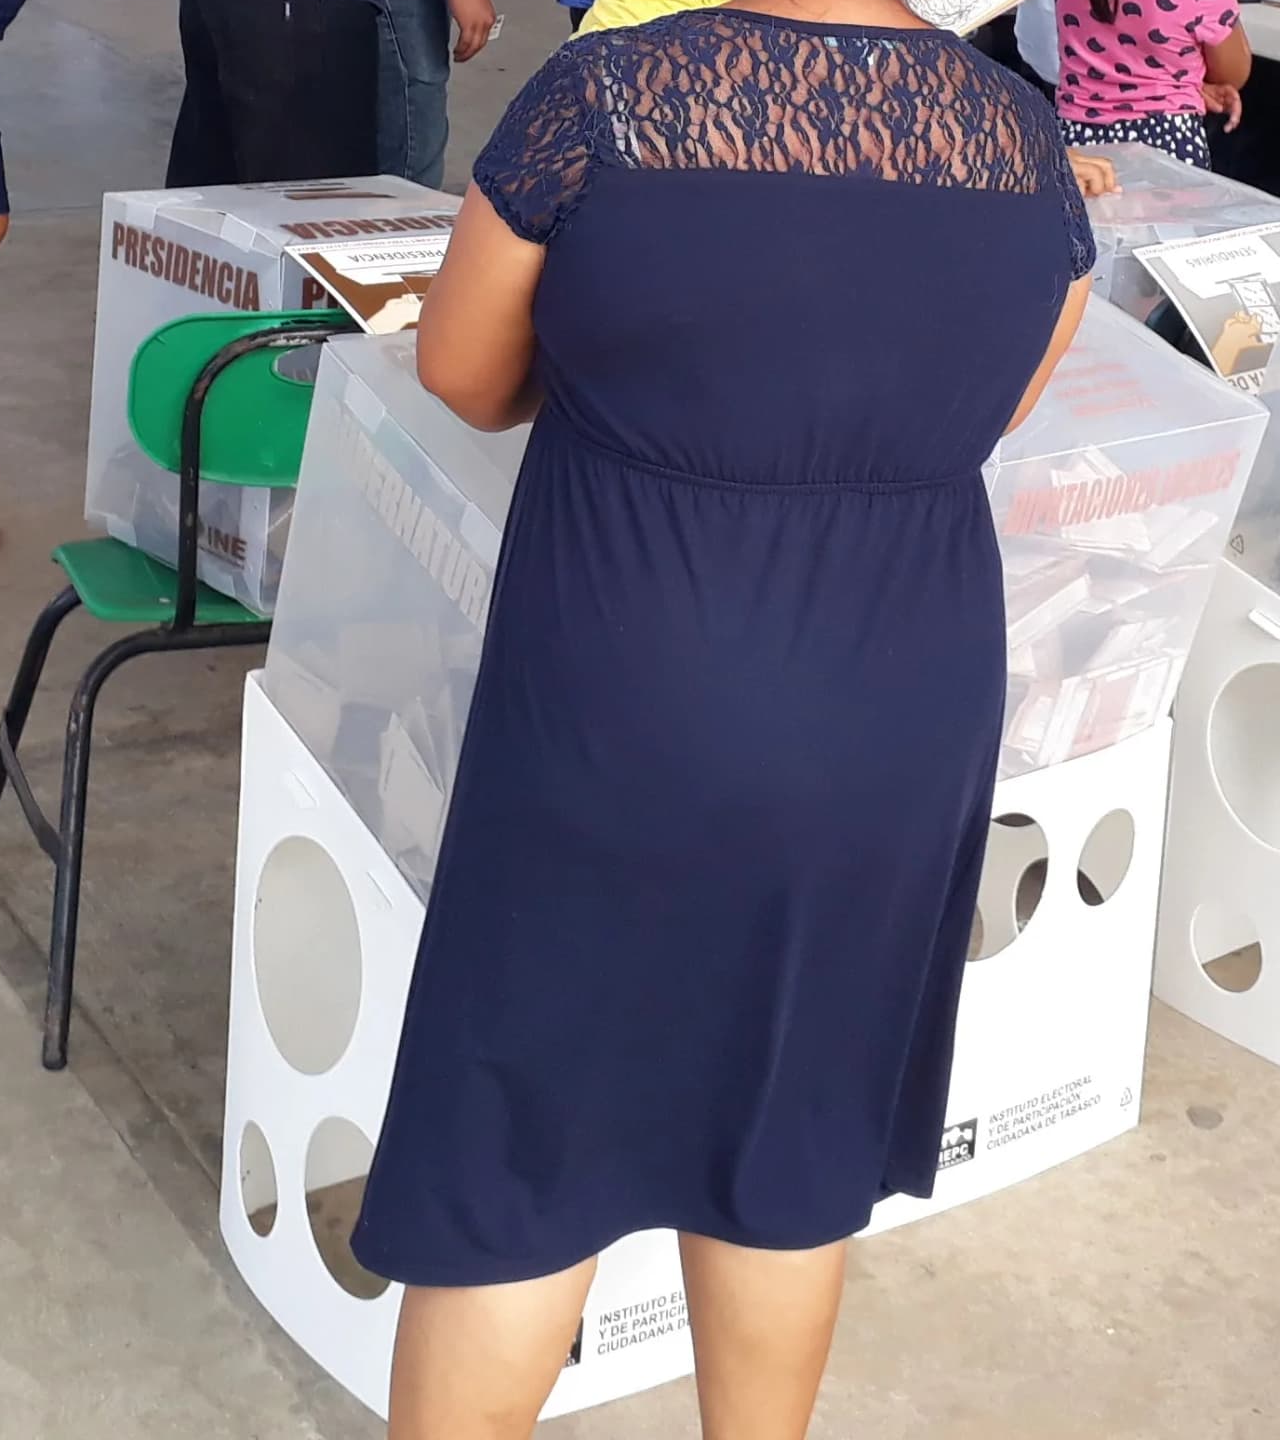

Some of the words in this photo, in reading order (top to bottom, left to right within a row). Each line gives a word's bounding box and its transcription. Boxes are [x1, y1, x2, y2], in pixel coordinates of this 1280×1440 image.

[111, 220, 261, 312] PRESIDENCIA
[207, 526, 248, 562] INE
[989, 1097, 1039, 1125] INSTITUTO
[1039, 1075, 1092, 1105] ELECTORAL
[986, 1120, 1043, 1151] CIUDADANA
[1045, 1115, 1057, 1128] DE
[1060, 1094, 1102, 1121] TABASCO
[996, 1122, 1010, 1134] DE
[599, 1295, 667, 1327] INSTITUTO
[670, 1290, 685, 1304] EL
[597, 1322, 674, 1356] CIUDADANA
[598, 1327, 607, 1340] Y
[610, 1322, 628, 1338] DE
